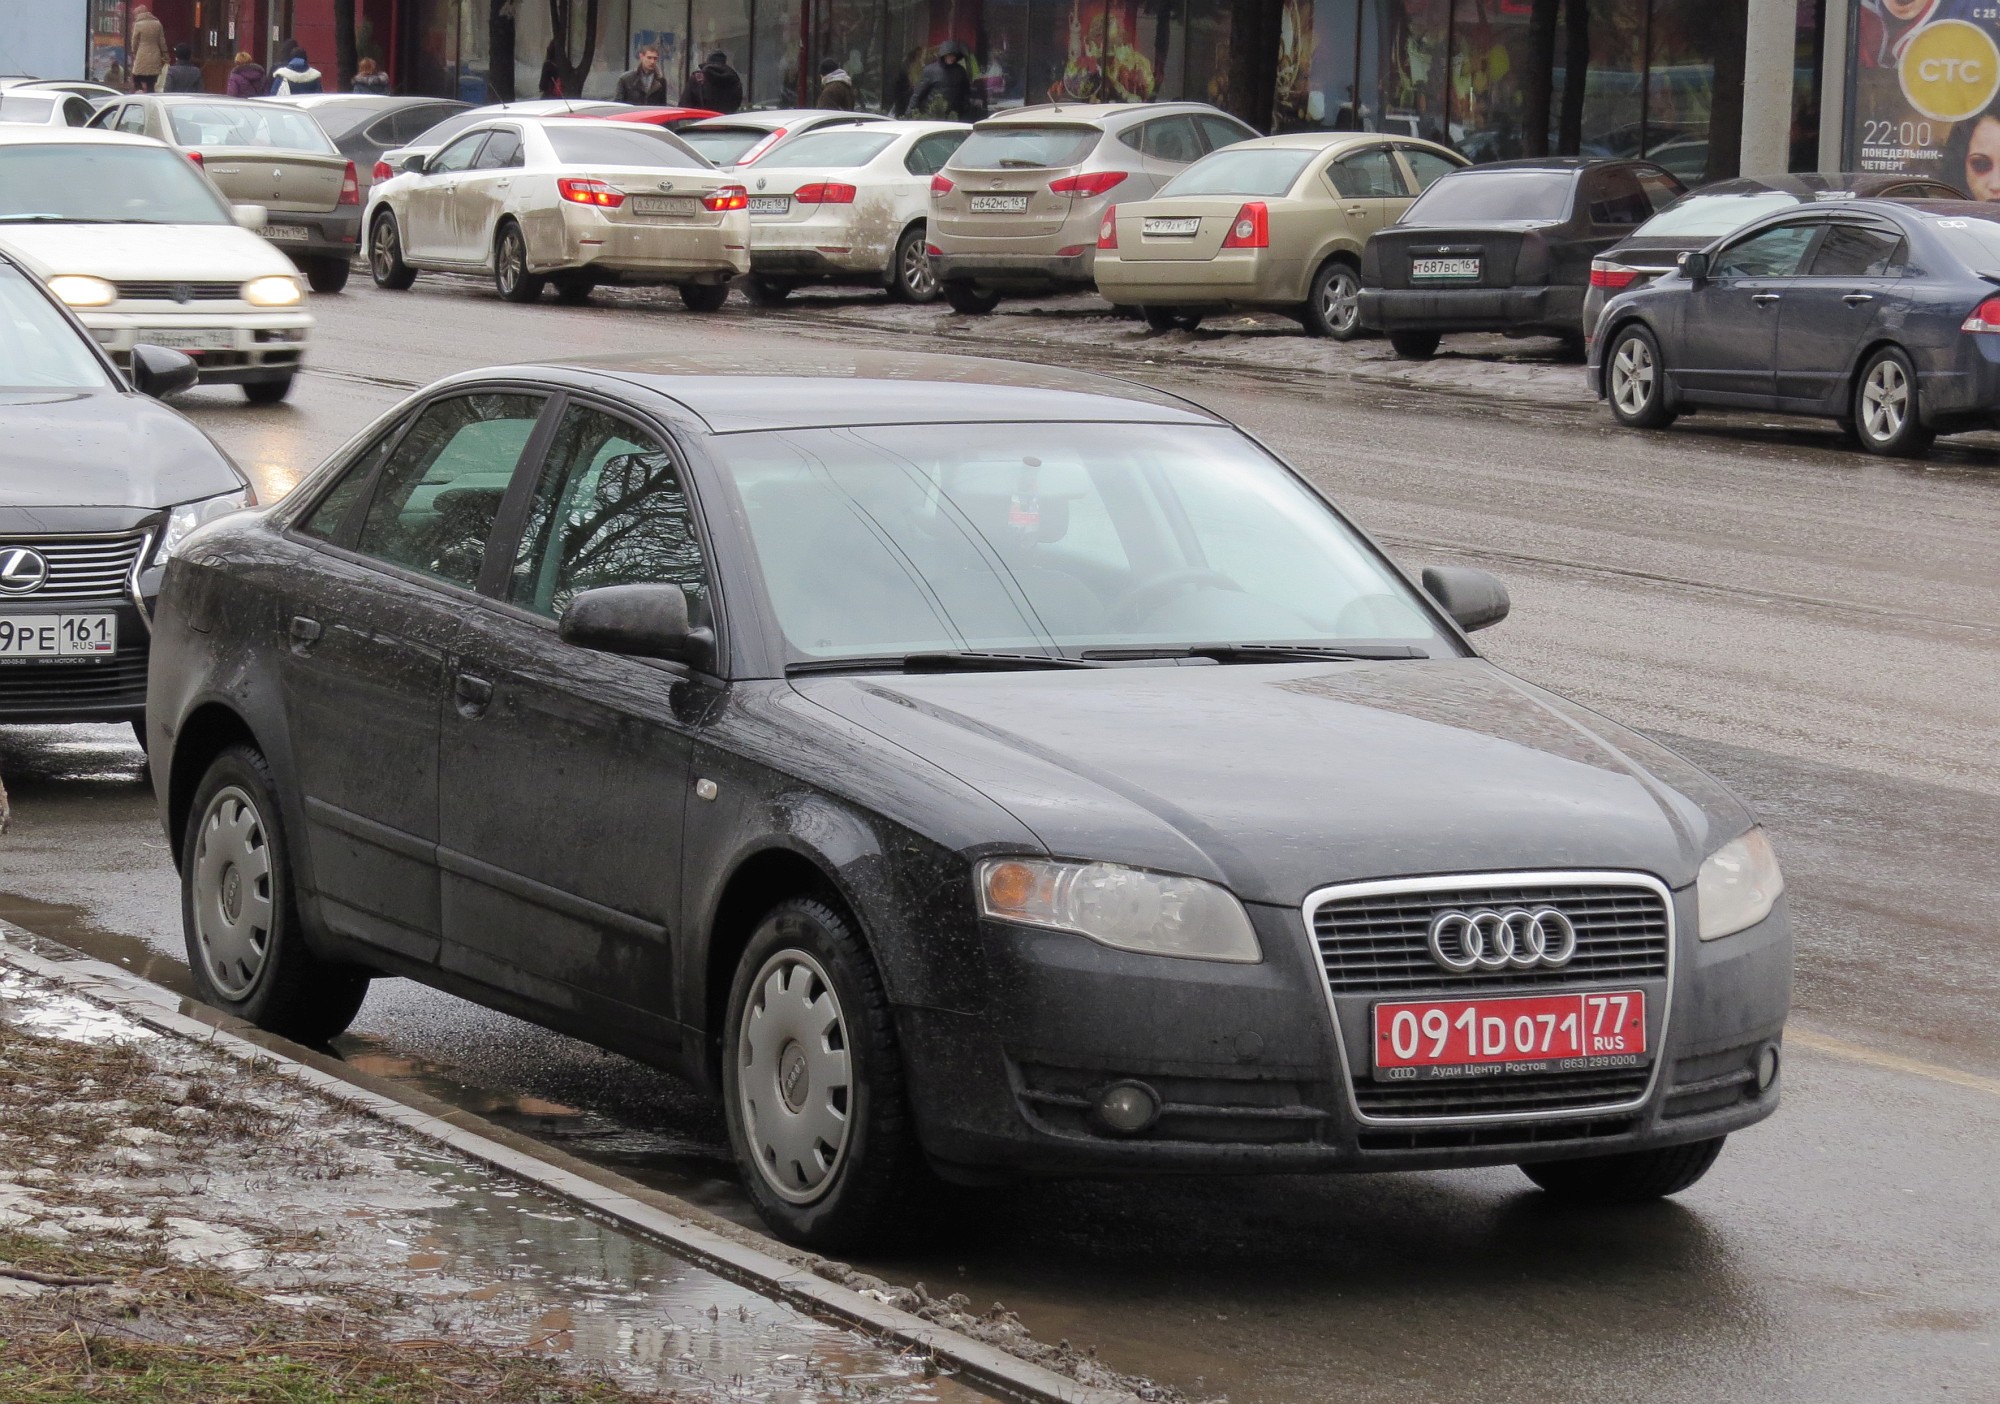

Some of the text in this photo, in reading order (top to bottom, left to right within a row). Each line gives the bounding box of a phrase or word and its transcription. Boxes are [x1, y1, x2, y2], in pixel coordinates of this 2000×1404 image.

[1919, 59, 1981, 83] СТС
[1863, 120, 1932, 147] 22:00
[1861, 148, 1943, 160] ПОНЕДЕЛЬНИК-
[1861, 160, 1905, 171] ЧЕТВЕРГ
[1417, 261, 1458, 273] Т687ВС
[62, 617, 108, 642] 161
[72, 641, 94, 651] RUS
[1588, 996, 1629, 1035] 77
[1593, 1035, 1625, 1051] RUS
[1431, 1065, 1462, 1078] Ауди
[1464, 1063, 1502, 1076] Центр
[1505, 1061, 1547, 1073] Ростов
[1559, 1057, 1588, 1071] (863)
